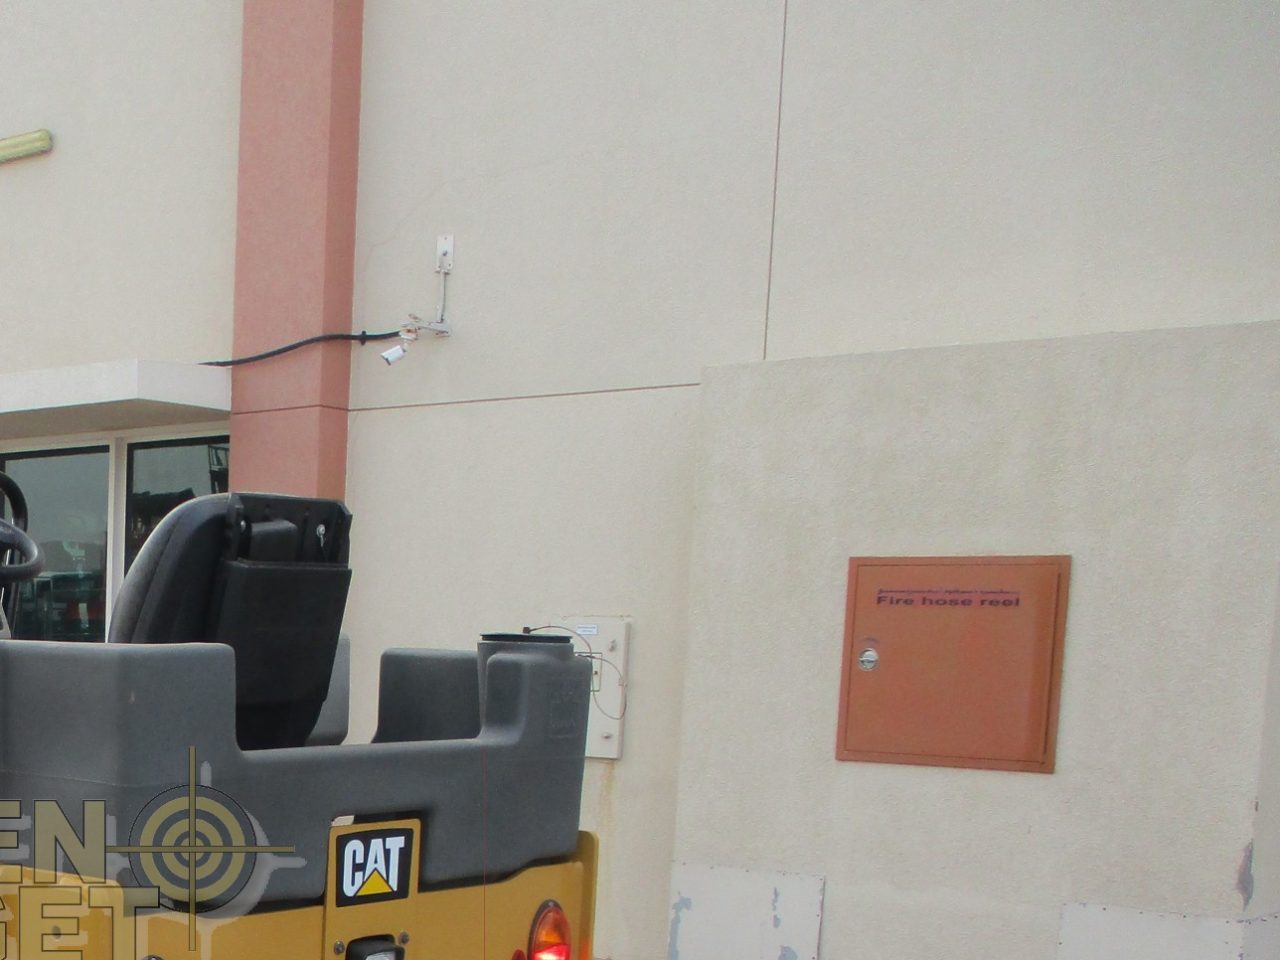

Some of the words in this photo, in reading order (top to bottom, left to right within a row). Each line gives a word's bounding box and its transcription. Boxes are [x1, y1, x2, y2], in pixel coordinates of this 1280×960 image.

[877, 595, 914, 606] Fire
[922, 596, 973, 607] hose
[980, 597, 1020, 607] reel
[342, 835, 405, 897] CAT
